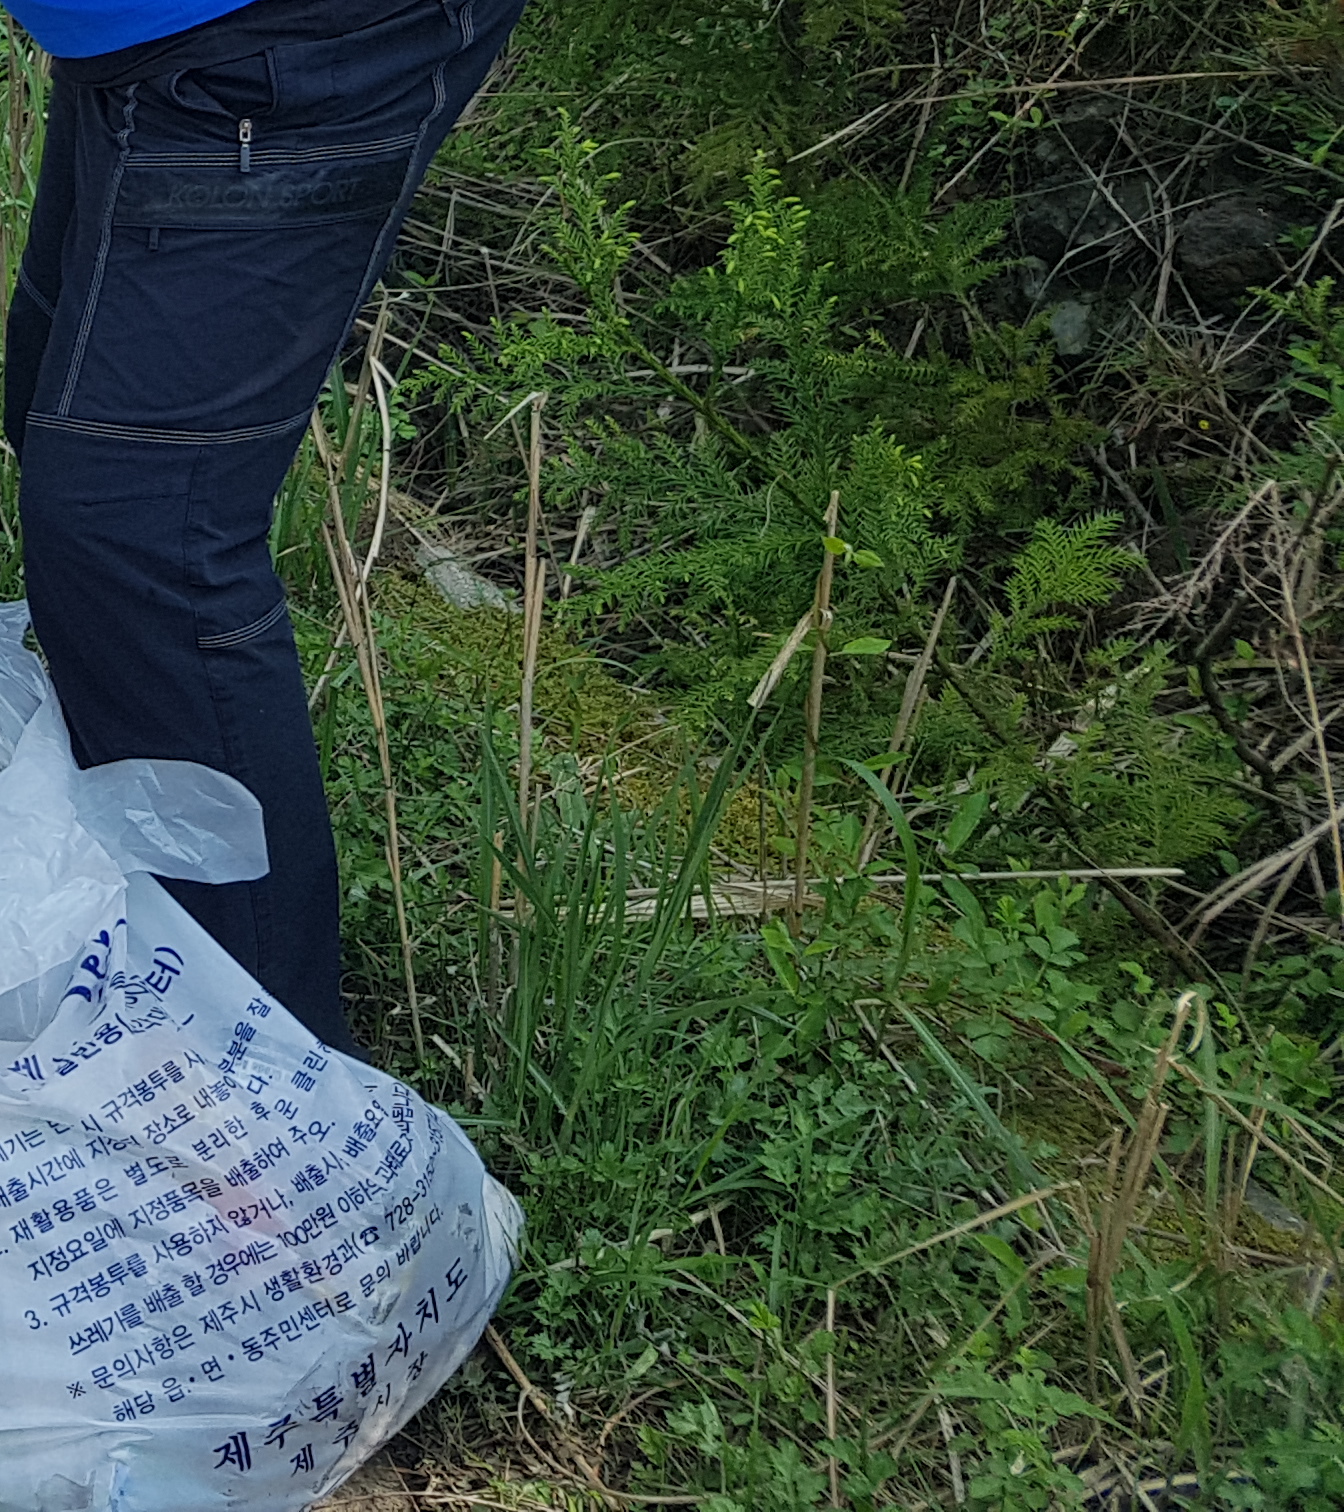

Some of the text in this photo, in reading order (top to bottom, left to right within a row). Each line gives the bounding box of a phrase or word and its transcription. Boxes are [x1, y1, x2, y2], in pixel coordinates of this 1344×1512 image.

[168, 179, 361, 208] KOLON SPORT
[100, 1059, 186, 1124] 규격봉투를
[142, 1103, 196, 1146] 장소로
[9, 1178, 119, 1244] 재활용품은
[191, 1115, 249, 1163] 분리한
[250, 1100, 272, 1121] 후
[27, 1217, 128, 1282] 지정요일에
[127, 1177, 224, 1230] 지정품목을
[223, 1136, 291, 1188] 배출하여
[24, 1309, 49, 1330] 3.
[48, 1252, 149, 1318] 규격봉투를
[152, 1214, 230, 1264] 사용하지
[227, 1188, 294, 1229] 않거나,
[68, 1302, 145, 1356] 쓰레기를
[142, 1282, 185, 1314] 배출
[181, 1270, 207, 1298] 할
[205, 1240, 279, 1286] 경우에는
[276, 1202, 339, 1249] 100만원
[90, 1324, 196, 1389] 문의사항은
[198, 1289, 262, 1335] 제주시
[113, 1389, 156, 1423] 해당
[241, 1290, 357, 1364] 동주민센터로
[359, 1258, 391, 1299] 문의
